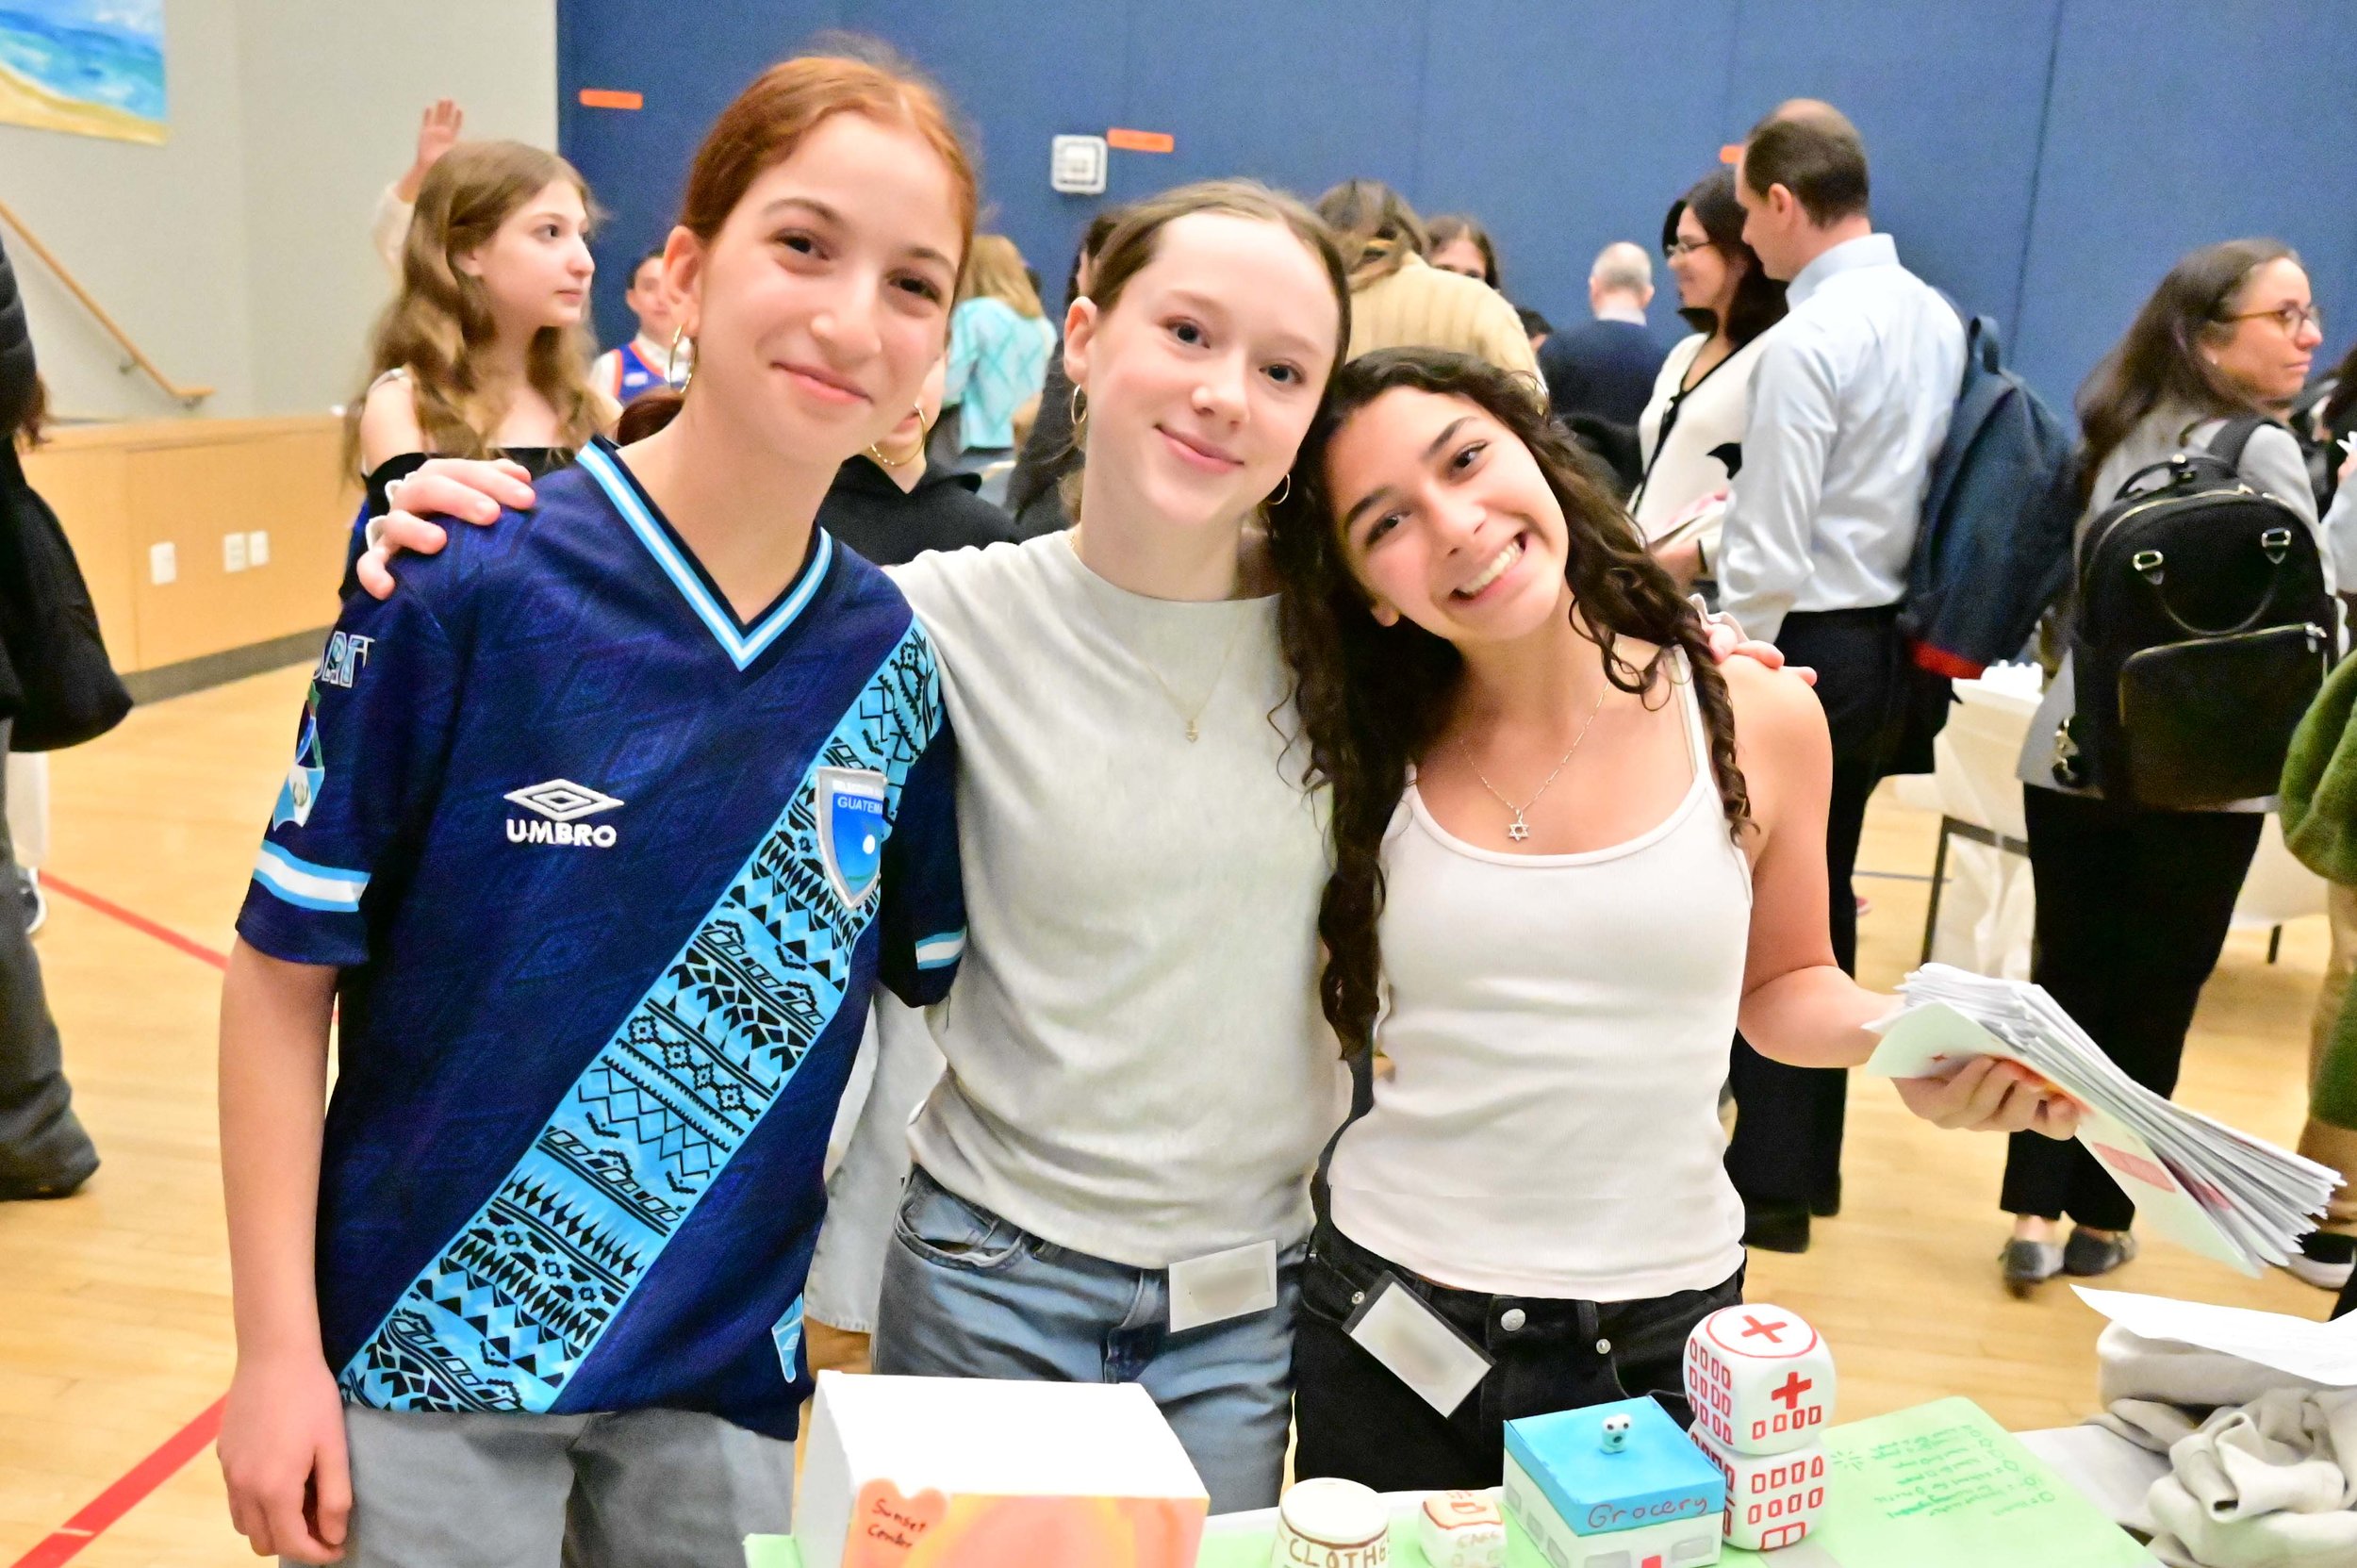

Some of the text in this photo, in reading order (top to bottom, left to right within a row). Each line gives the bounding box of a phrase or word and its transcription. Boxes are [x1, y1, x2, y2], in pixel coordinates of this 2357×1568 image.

[506, 818, 618, 848] UMBRO
[871, 1498, 927, 1532] Sunset
[1587, 1497, 1707, 1528] Grocery
[1289, 1536, 1390, 1568] CLOTHE
